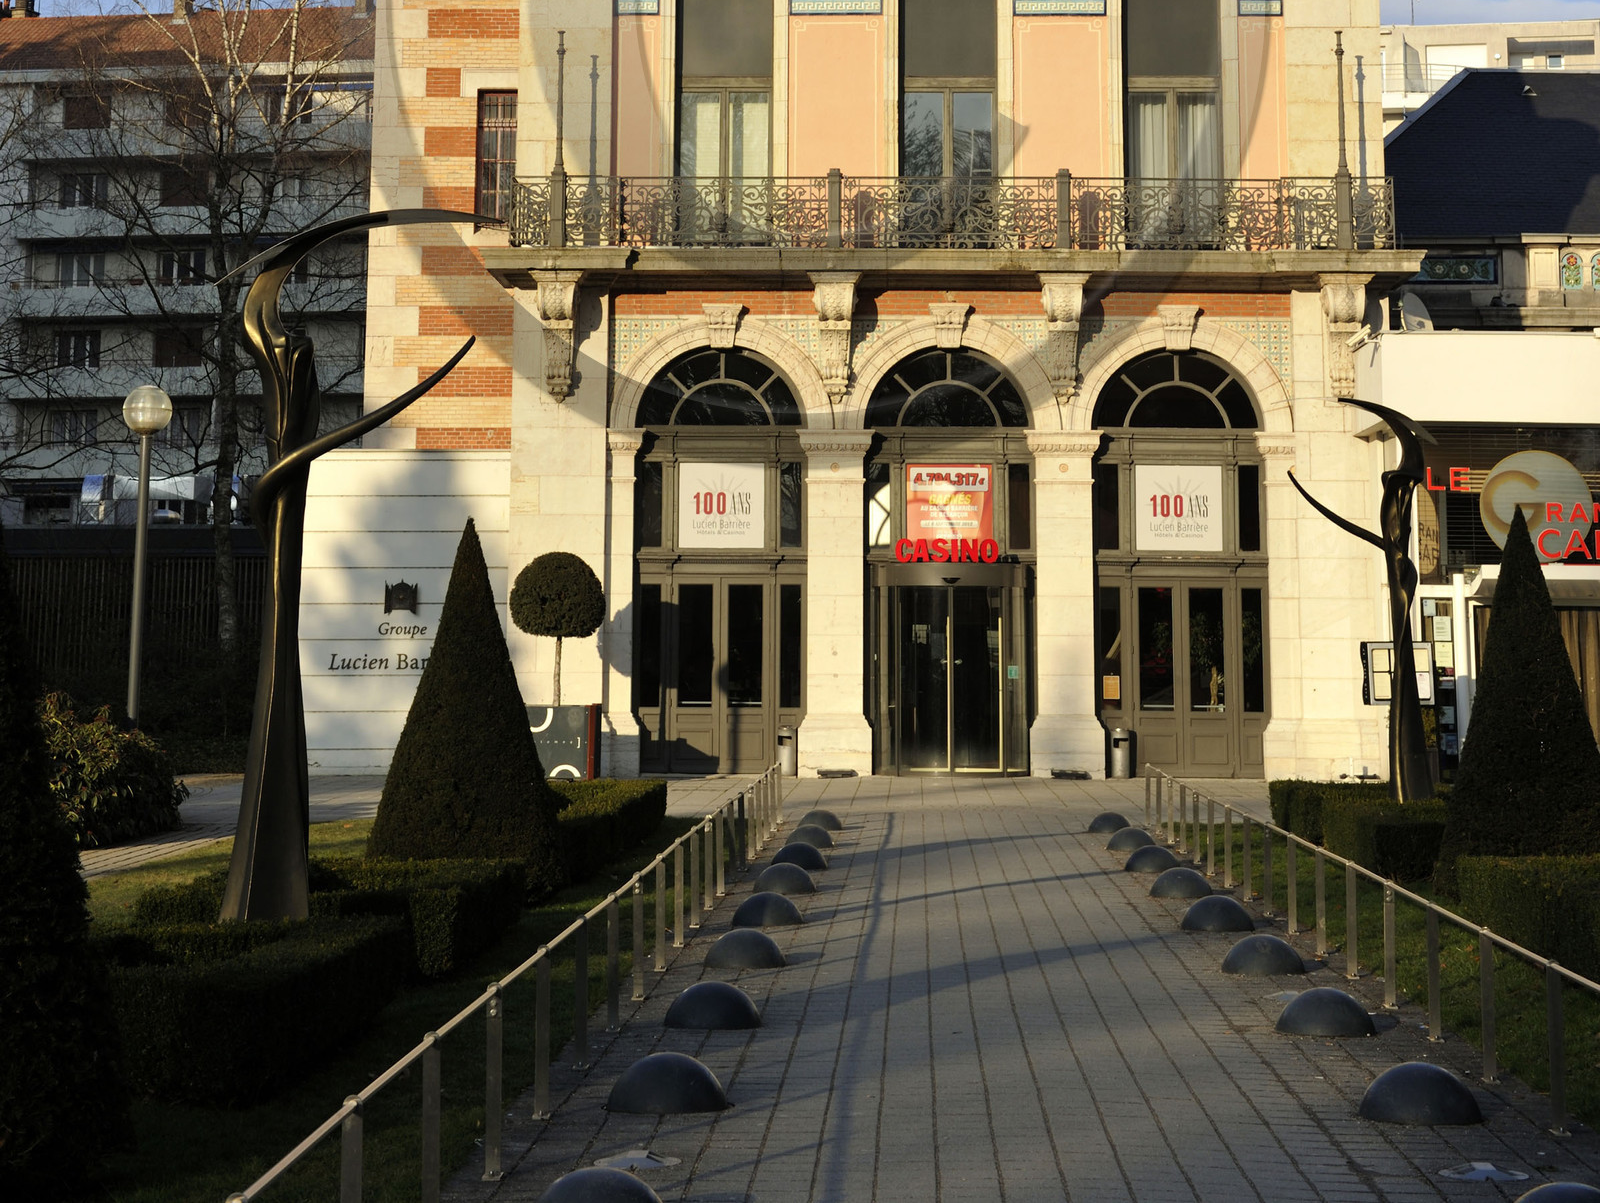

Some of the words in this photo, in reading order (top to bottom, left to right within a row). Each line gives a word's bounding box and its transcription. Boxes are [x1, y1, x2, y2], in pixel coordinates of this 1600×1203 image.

[1426, 466, 1471, 491] LE
[693, 491, 727, 515] 100
[729, 491, 751, 515] ANS
[1149, 494, 1184, 518] 100
[1186, 494, 1209, 518] ANS
[692, 519, 717, 529] Lucien
[719, 519, 751, 529] Barrière
[1149, 521, 1175, 532] Lucien
[1177, 521, 1209, 532] Barrière
[895, 538, 999, 563] CASINO
[378, 622, 428, 638] Groupe
[328, 653, 389, 671] Lucien
